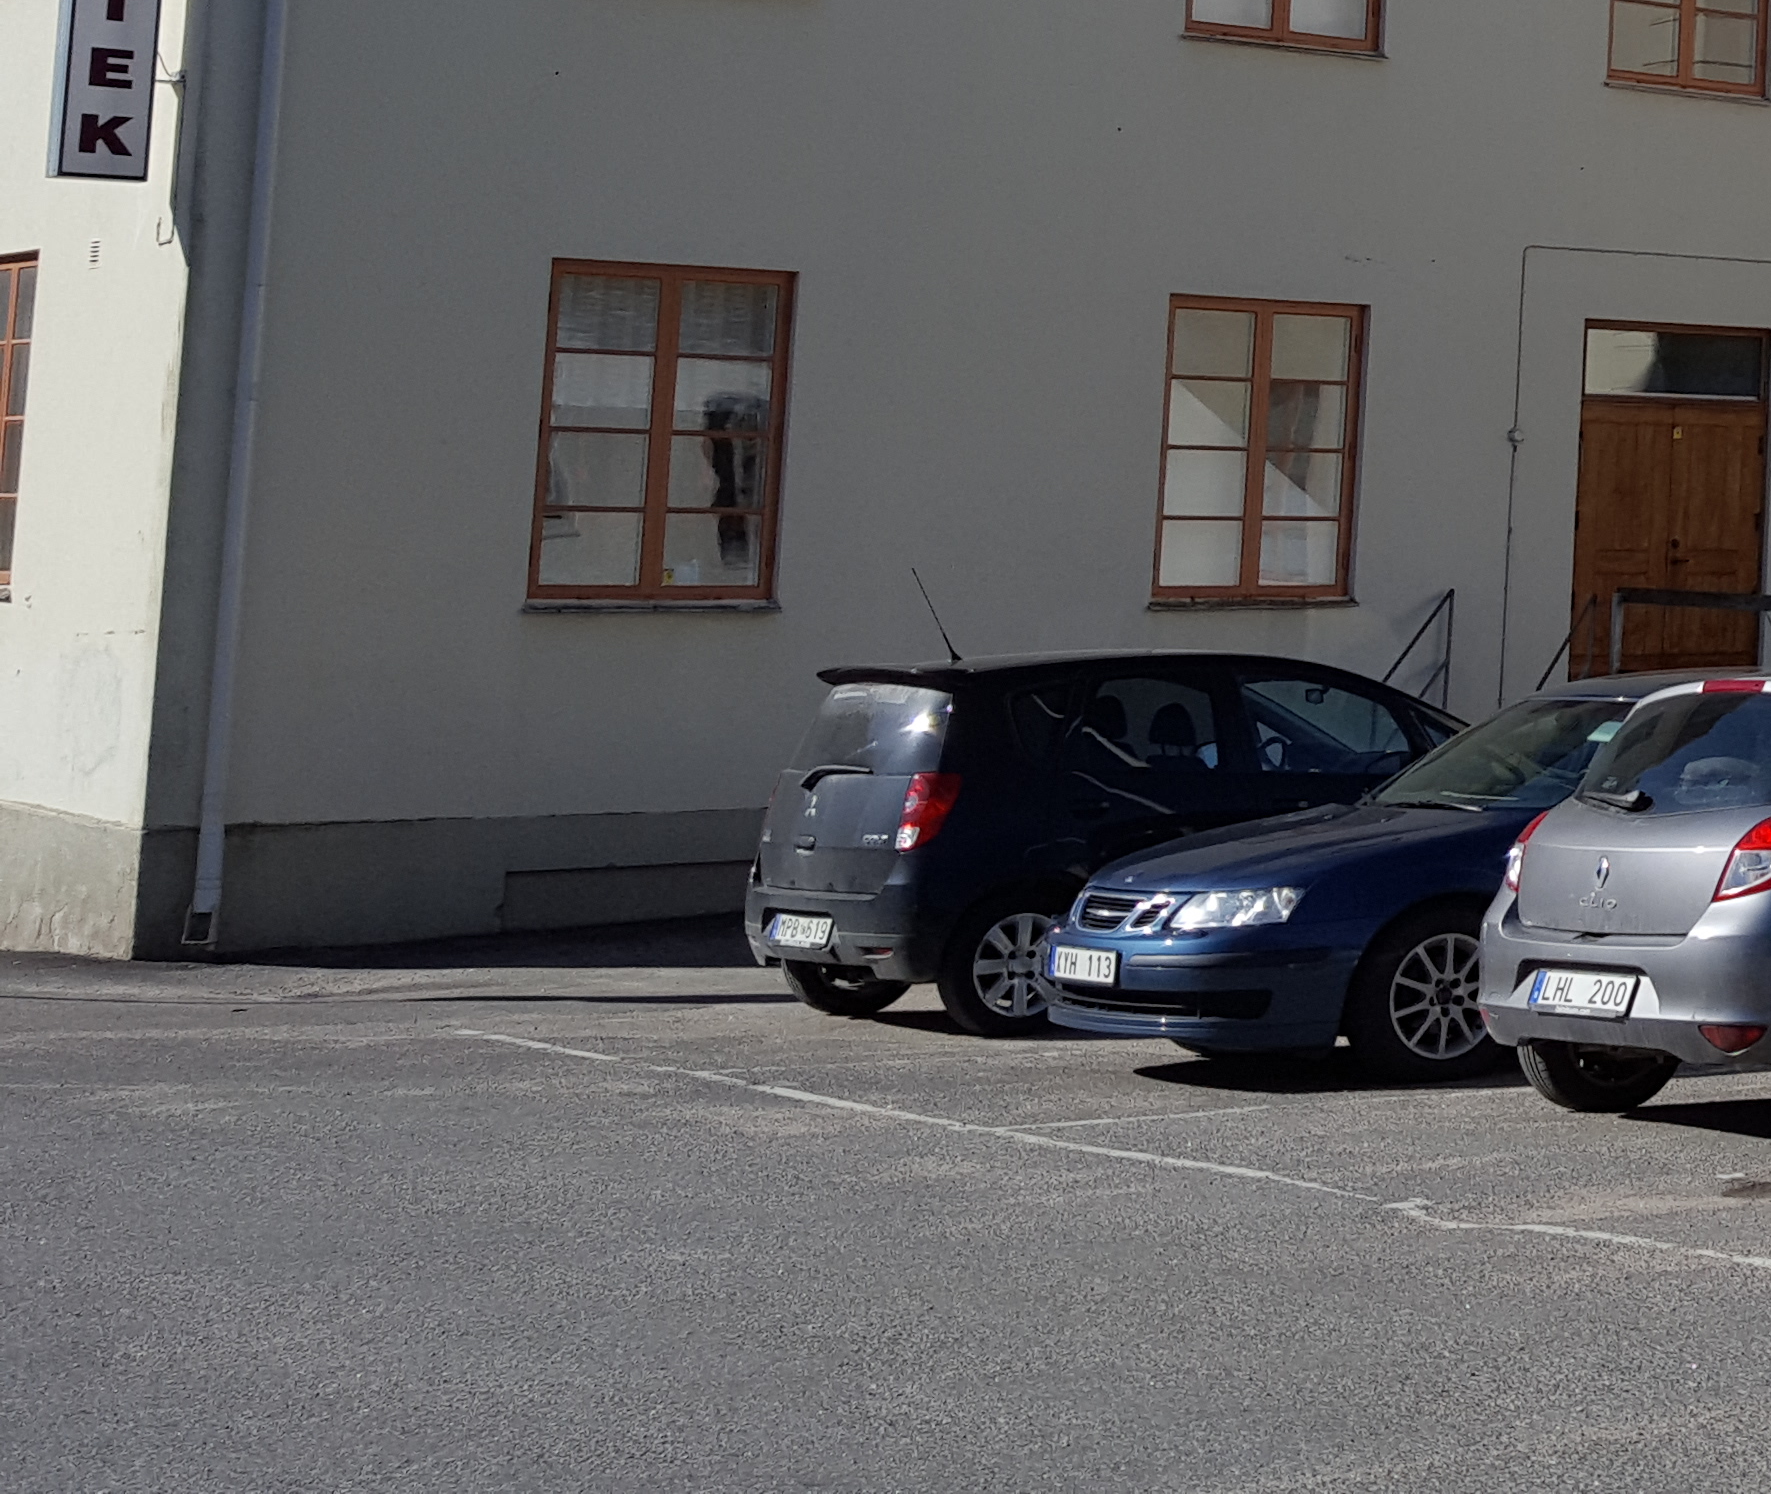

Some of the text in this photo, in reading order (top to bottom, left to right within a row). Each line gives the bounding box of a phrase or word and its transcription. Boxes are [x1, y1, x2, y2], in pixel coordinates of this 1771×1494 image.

[805, 919, 828, 940] 619
[1087, 953, 1112, 979] 113
[1541, 975, 1628, 1007] LHL 200
